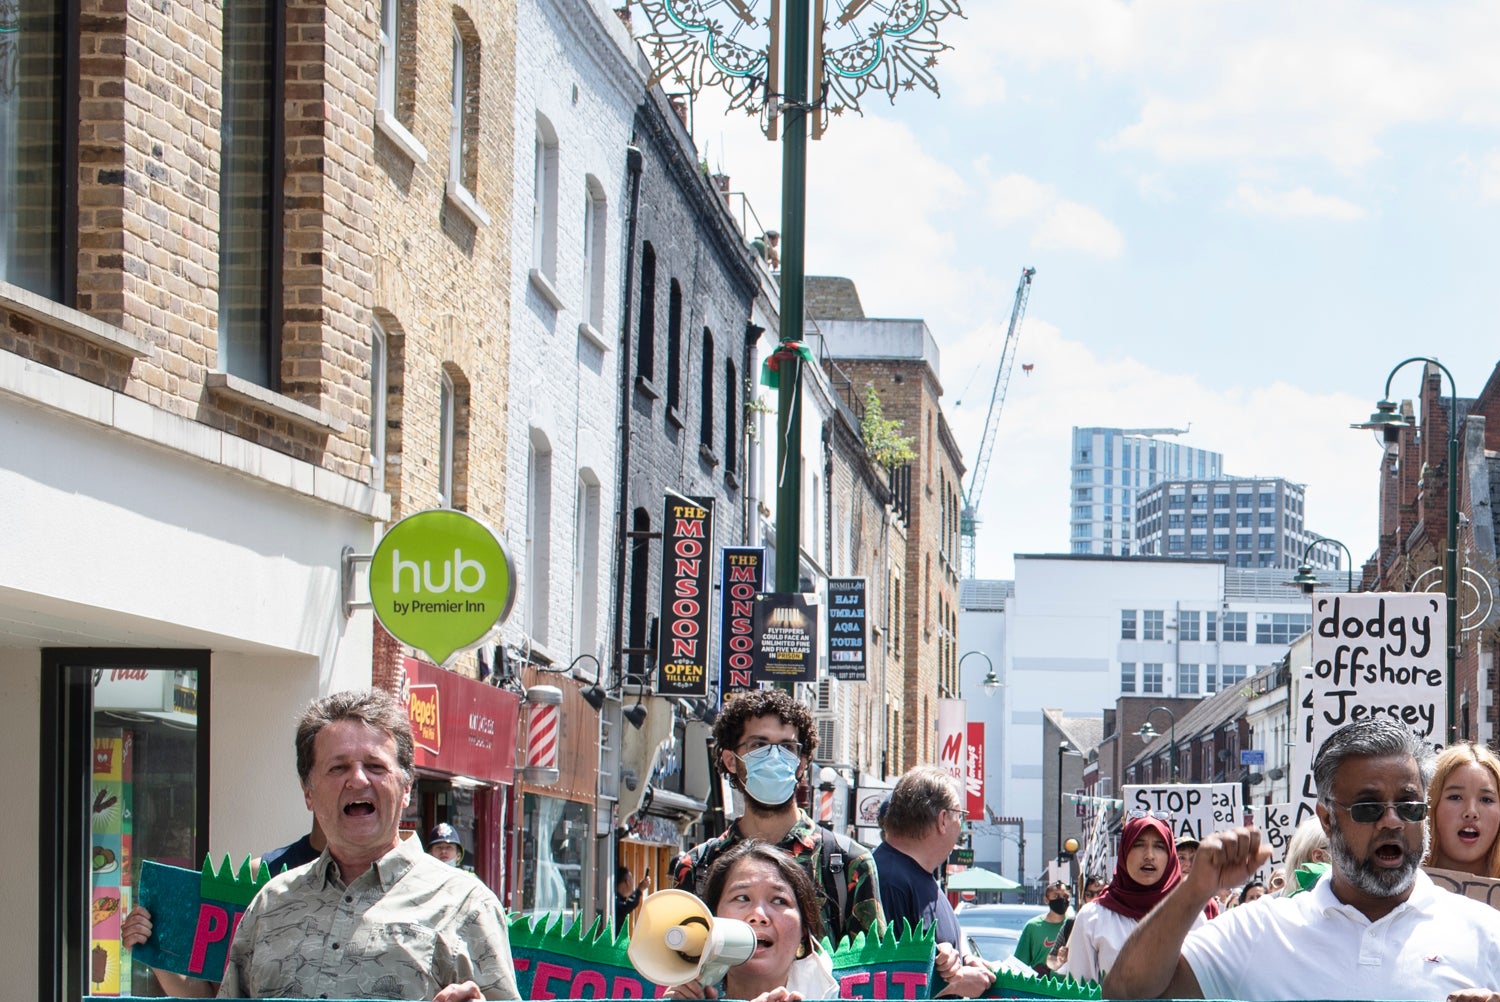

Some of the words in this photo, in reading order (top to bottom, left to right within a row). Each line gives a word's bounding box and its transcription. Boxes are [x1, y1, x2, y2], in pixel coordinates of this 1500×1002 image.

[673, 505, 707, 519] THE
[729, 555, 758, 566] THE
[392, 548, 486, 594] hub
[671, 519, 705, 658] MONSOON
[393, 600, 409, 615] by
[412, 599, 464, 613] Premier
[466, 600, 485, 613] Inn
[835, 595, 859, 604] HAJJ
[829, 608, 865, 618] UMRAH
[729, 566, 758, 687] MONSOON
[768, 627, 804, 635] FLYTIPPERS
[834, 622, 860, 633] AQSA
[831, 638, 862, 647] TOURS
[664, 663, 703, 676] OPEN
[1315, 645, 1442, 687] offshore
[666, 674, 682, 682] TILL
[682, 675, 700, 683] LATE
[410, 692, 436, 732] Pepe's
[1323, 690, 1434, 736] Jersey
[945, 767, 961, 779] AR
[1135, 789, 1201, 815] STOP
[1212, 785, 1236, 807] cal
[1265, 807, 1289, 829] Ke
